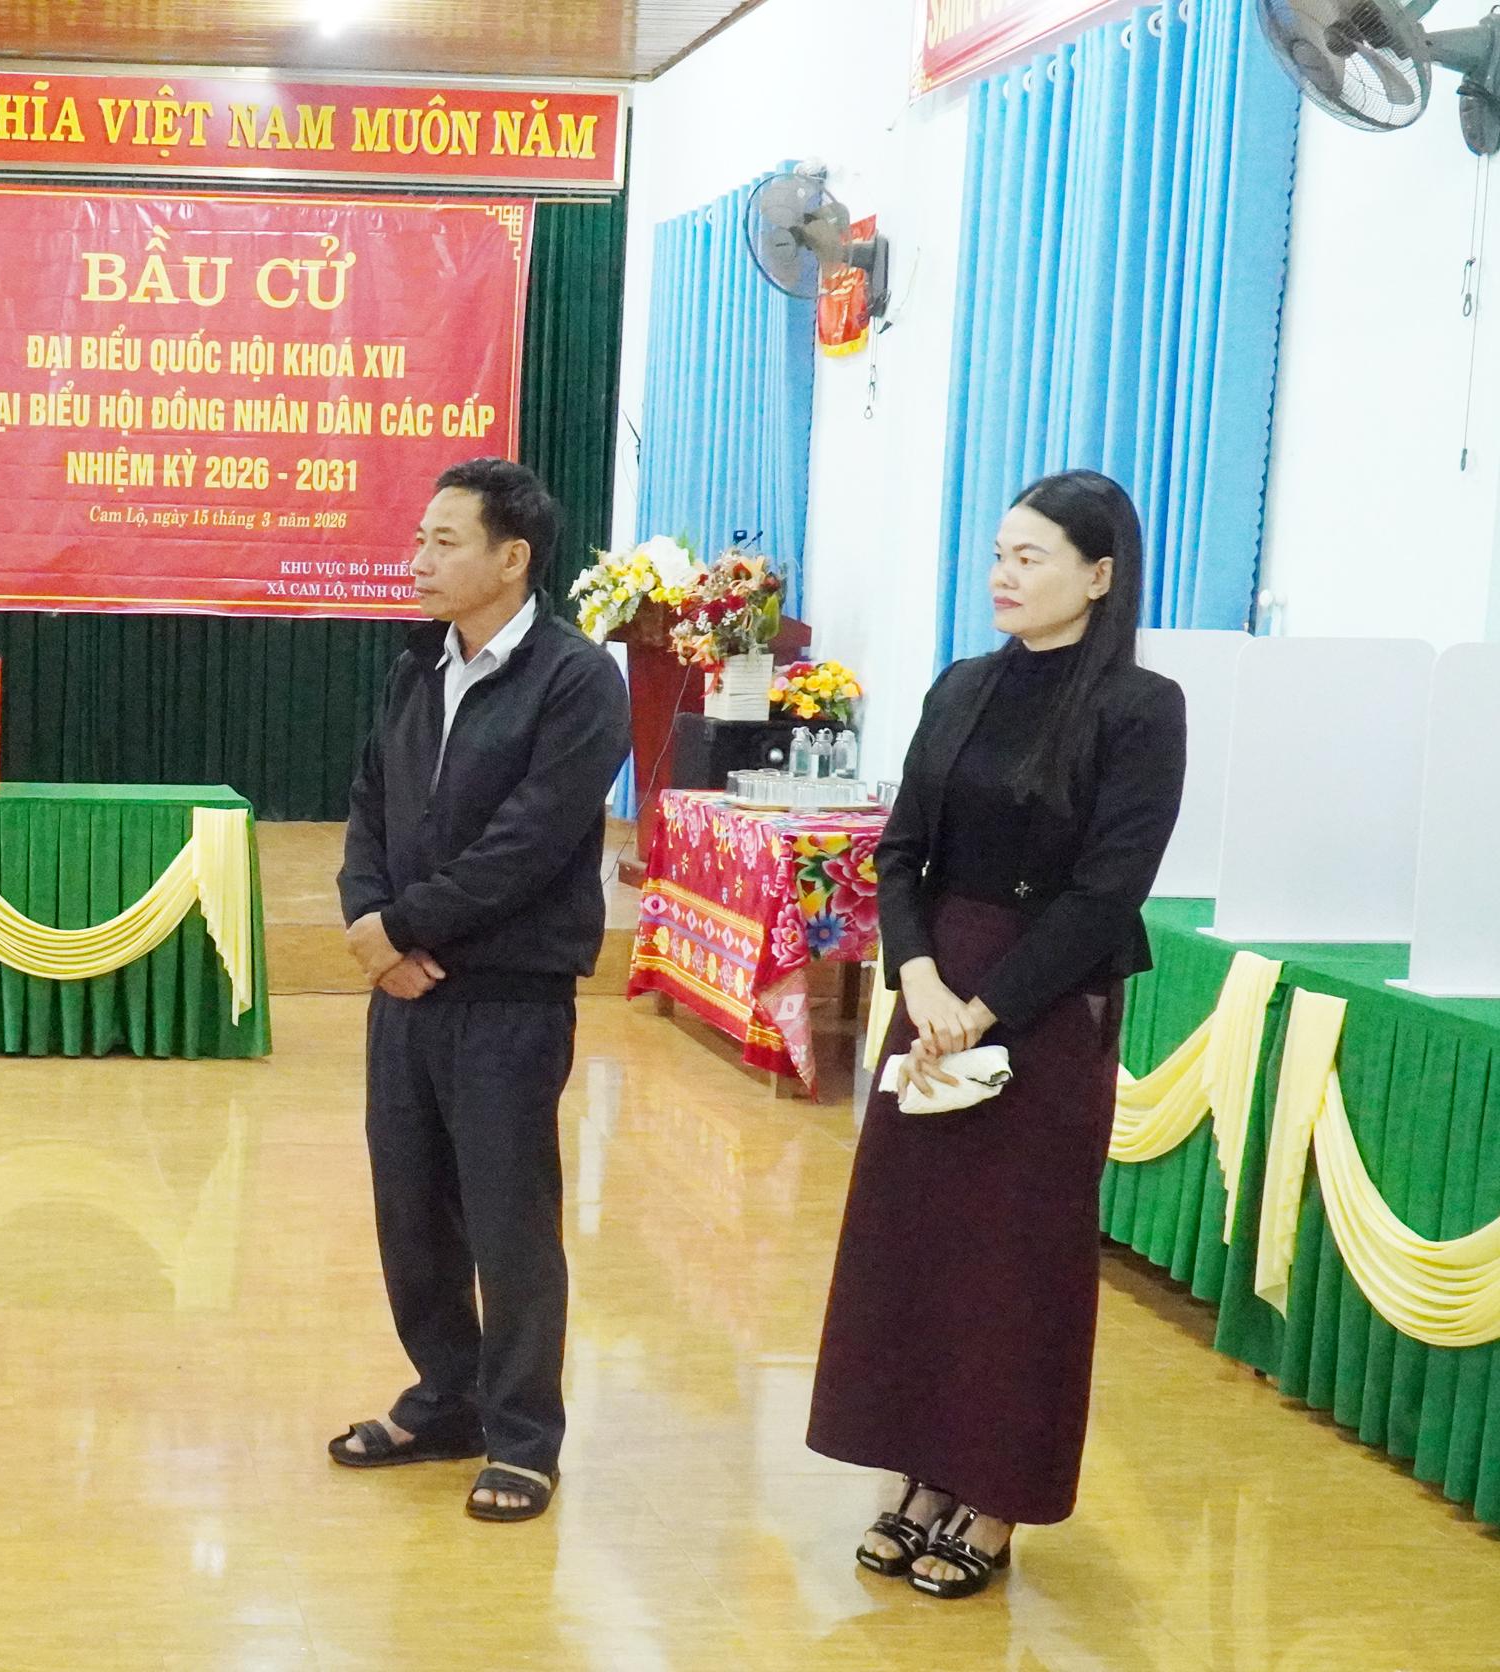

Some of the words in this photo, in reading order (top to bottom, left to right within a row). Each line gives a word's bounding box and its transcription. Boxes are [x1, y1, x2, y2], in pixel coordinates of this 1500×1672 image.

[98, 85, 212, 157] VIỆT
[228, 104, 336, 151] NAM
[350, 95, 481, 155] MUÔN
[492, 99, 598, 158] NĂM
[80, 225, 234, 305] BẦU
[255, 235, 357, 311] CỬ
[26, 333, 72, 371] ĐẠI
[80, 323, 142, 371] BIỂU
[149, 328, 223, 376] QUỐC
[230, 334, 276, 382] HỘI
[283, 336, 356, 376] KHOÁ
[363, 338, 407, 378] XVI
[28, 380, 92, 427] BIỂU
[99, 387, 144, 437] HỘI
[151, 385, 225, 431] ĐỒNG
[231, 393, 308, 433] NHÂN
[316, 394, 372, 436] DÂN
[380, 395, 434, 437] CÁC
[442, 393, 494, 437] CẤP
[67, 446, 154, 493] NHIỆM
[163, 448, 197, 487] KỲ
[204, 456, 269, 489] 2026
[296, 458, 356, 491] 2031
[90, 505, 121, 522] Cam
[125, 506, 150, 528] Lộ,
[152, 508, 189, 528] ngày
[193, 509, 209, 525] 15
[213, 509, 256, 529] tháng
[262, 512, 271, 527] 3
[278, 512, 310, 527] năm
[313, 513, 347, 528] 2026
[267, 580, 286, 595] XÃ
[290, 583, 320, 597] CAM
[325, 581, 348, 600] LỘ,
[352, 581, 387, 598] TỈNH
[280, 561, 312, 574] KHU
[316, 562, 346, 577] VỰC
[349, 559, 369, 576] BỎ
